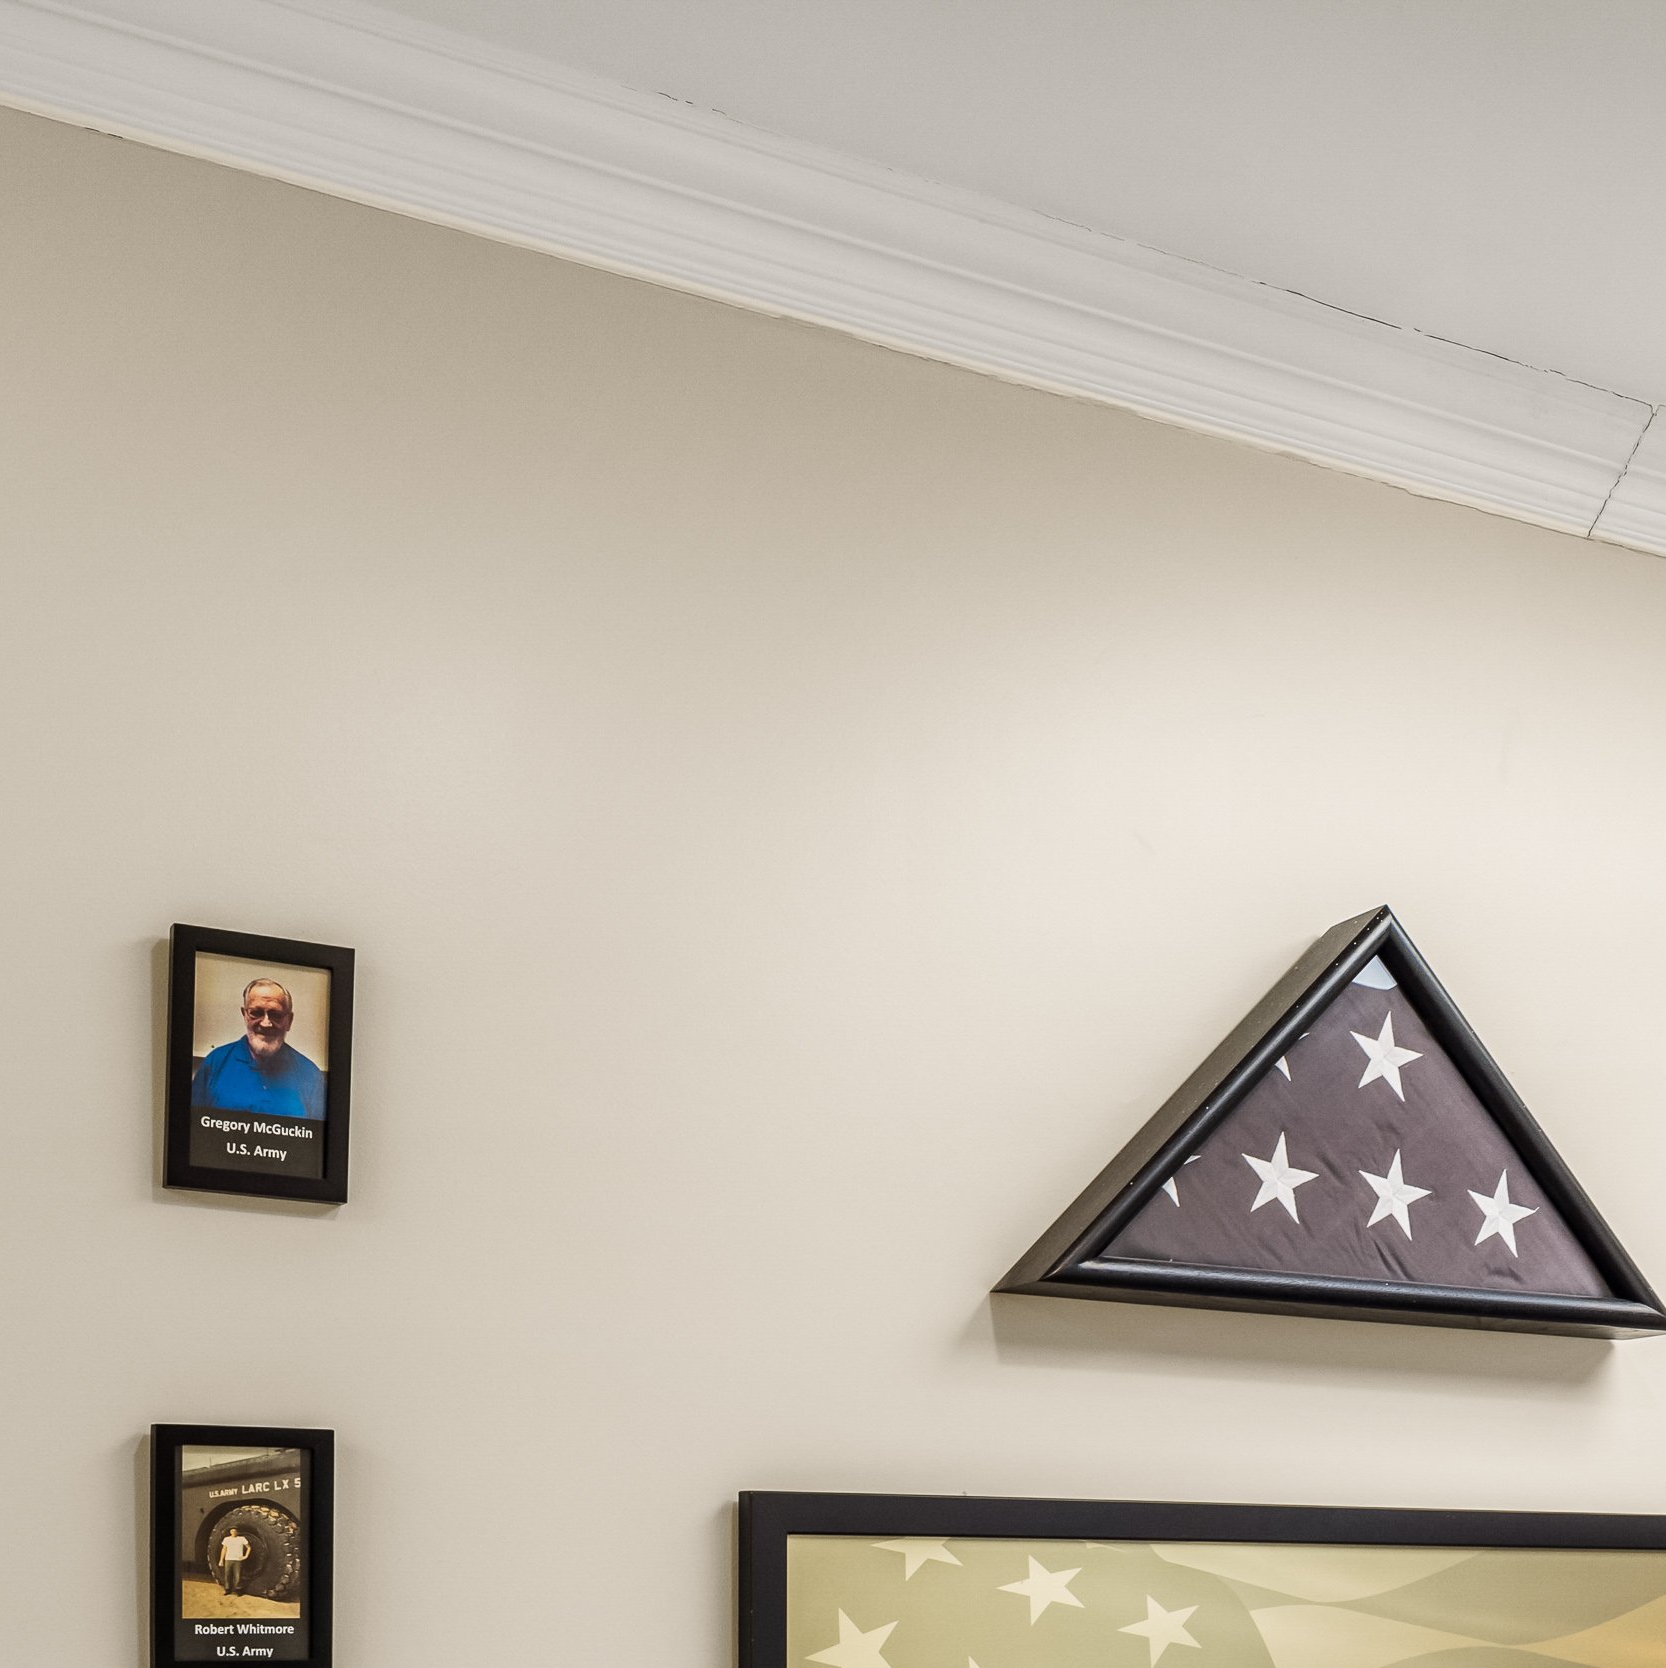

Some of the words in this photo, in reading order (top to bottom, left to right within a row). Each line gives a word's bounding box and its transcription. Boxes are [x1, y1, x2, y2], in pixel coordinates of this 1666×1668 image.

[200, 1115, 250, 1134] Gregory
[253, 1121, 313, 1139] McGuckin
[226, 1142, 251, 1156] U.S.
[253, 1145, 287, 1161] Army
[241, 1482, 270, 1494] LARC
[194, 1624, 235, 1635] Robert
[237, 1624, 295, 1635] Whitmore
[216, 1646, 240, 1657] U.S.
[242, 1646, 274, 1658] Army
